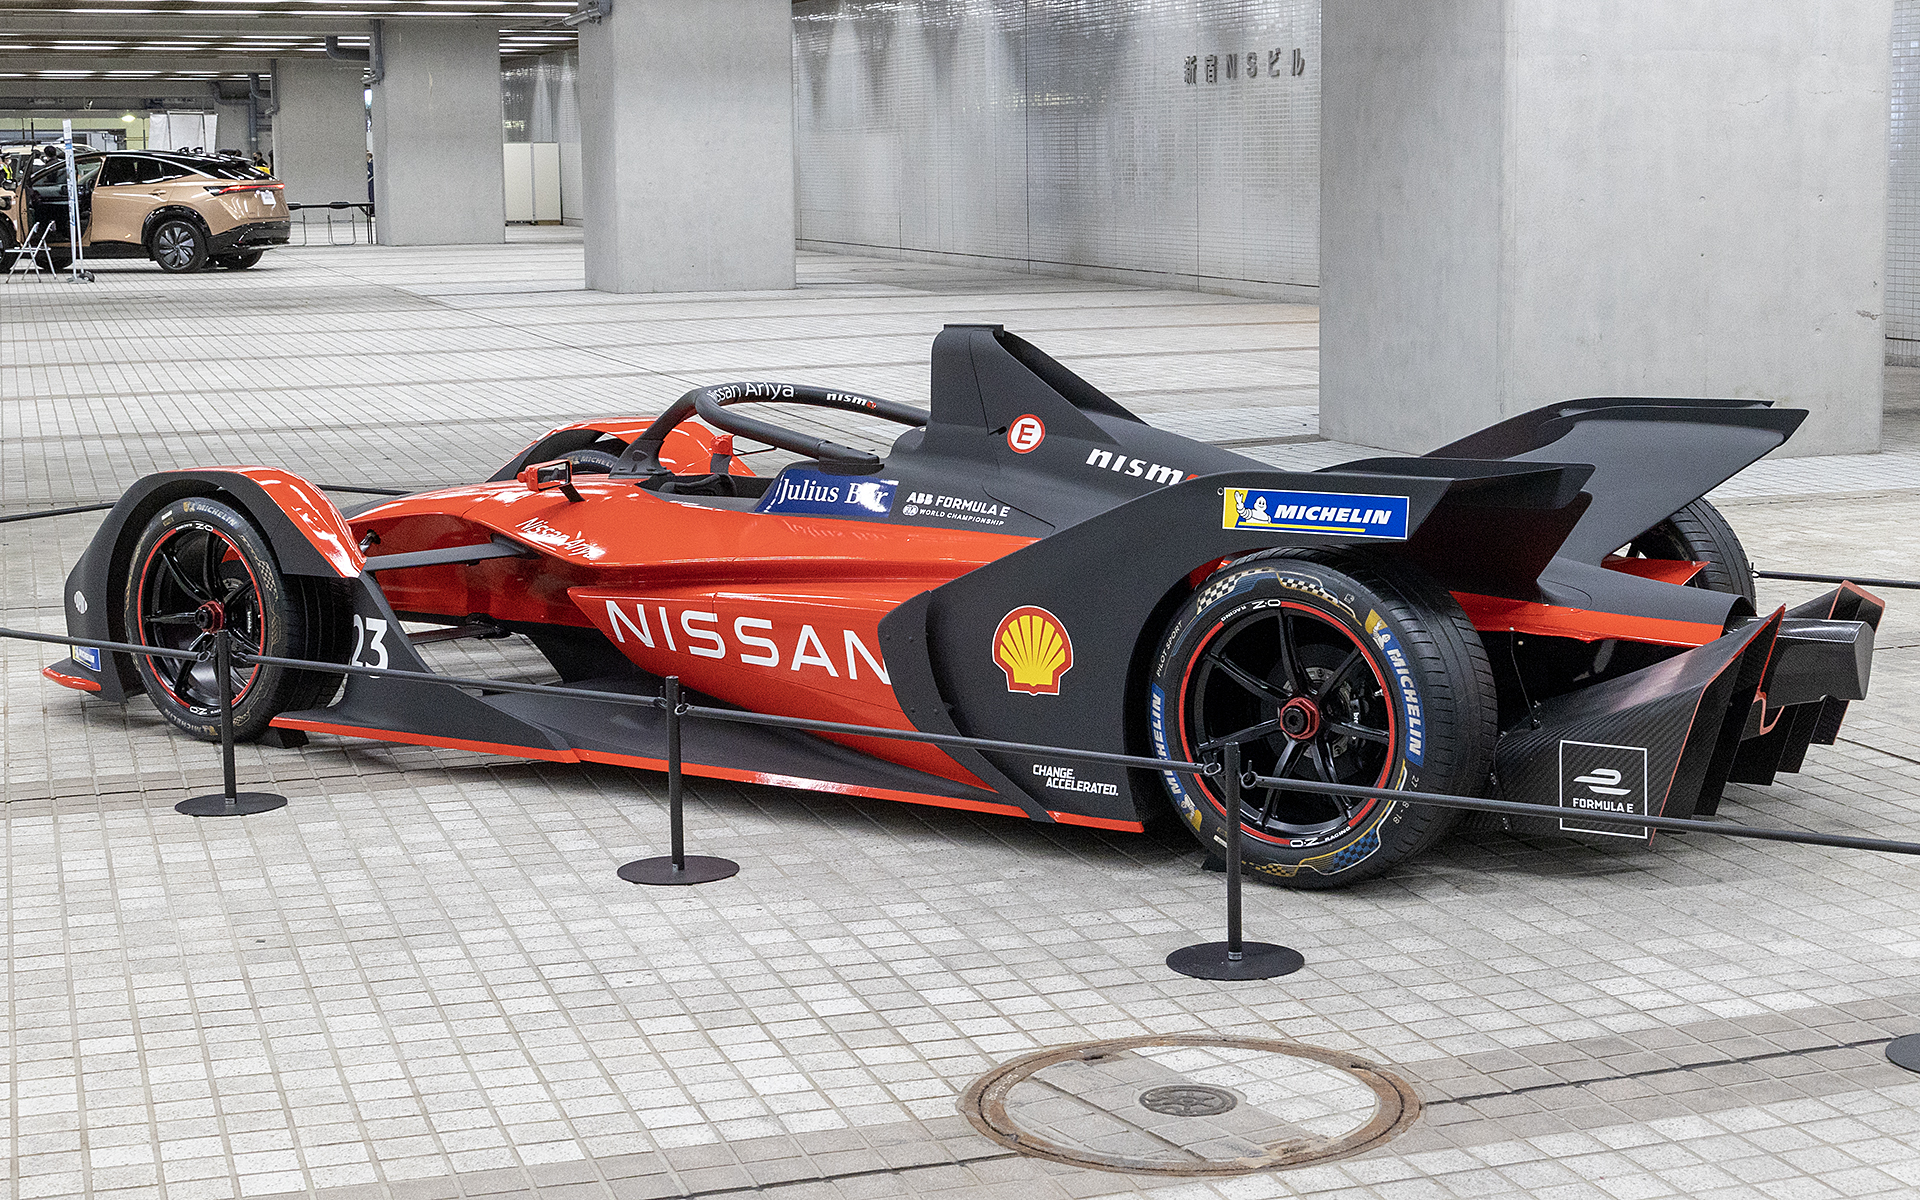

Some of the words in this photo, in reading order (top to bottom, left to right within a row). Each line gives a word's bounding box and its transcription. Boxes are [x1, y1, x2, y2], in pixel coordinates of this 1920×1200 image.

[1184, 48, 1305, 84] 新宿NSビル
[745, 381, 795, 400] Ariya
[826, 392, 877, 410] nismo
[1016, 423, 1035, 444] E
[580, 455, 614, 468] MICHELI
[1086, 448, 1198, 486] nism
[778, 478, 839, 504] Julius
[844, 482, 889, 512] Br
[906, 491, 934, 505] ABB
[935, 495, 997, 516] FORMULA
[999, 506, 1011, 517] E
[196, 503, 237, 527] MICHELIN
[919, 508, 945, 517] WORLD
[946, 512, 1005, 526] CHAMPIONSHIP
[1274, 504, 1392, 525] MICHELIN
[1220, 604, 1247, 621] RACING
[351, 613, 389, 679] 23
[605, 599, 892, 686] NISSAN
[1156, 648, 1168, 678] PILOT
[1166, 620, 1183, 649] SPORT
[1386, 648, 1422, 756] MICHELIN
[1152, 693, 1182, 795] MIHELIN
[1032, 764, 1076, 780] CHANGE.
[1045, 777, 1119, 797] ACCELERATED.
[1572, 797, 1625, 813] FORMULA
[1626, 803, 1634, 814] E
[1324, 826, 1351, 842] RACING
